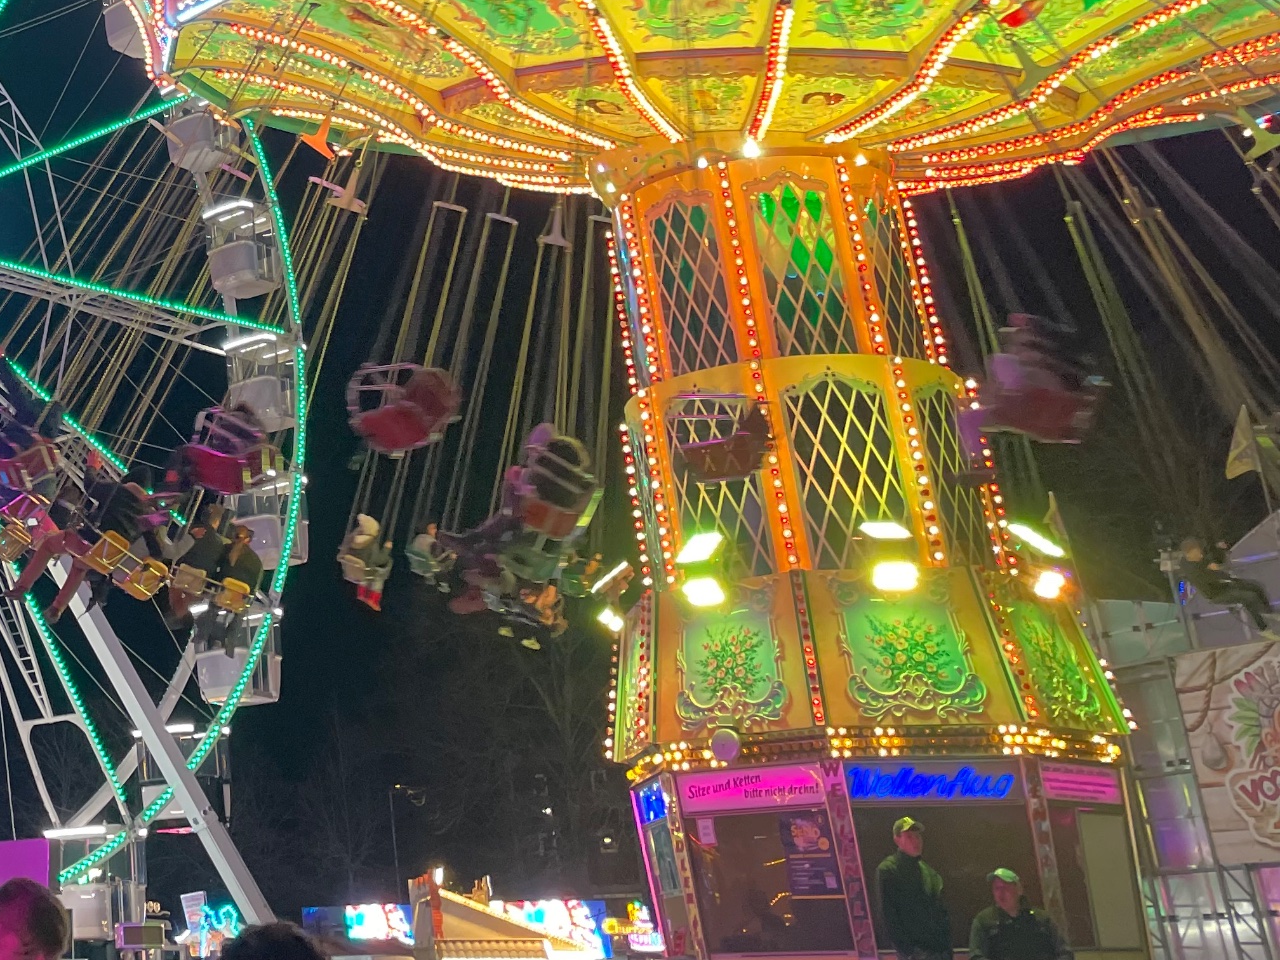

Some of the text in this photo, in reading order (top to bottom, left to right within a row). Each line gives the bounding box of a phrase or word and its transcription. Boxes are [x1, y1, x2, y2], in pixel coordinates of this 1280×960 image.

[688, 775, 762, 799] Sitze und Ketten
[744, 782, 819, 799] bitte nicht drehn!
[848, 766, 1015, 799] Wellenflug
